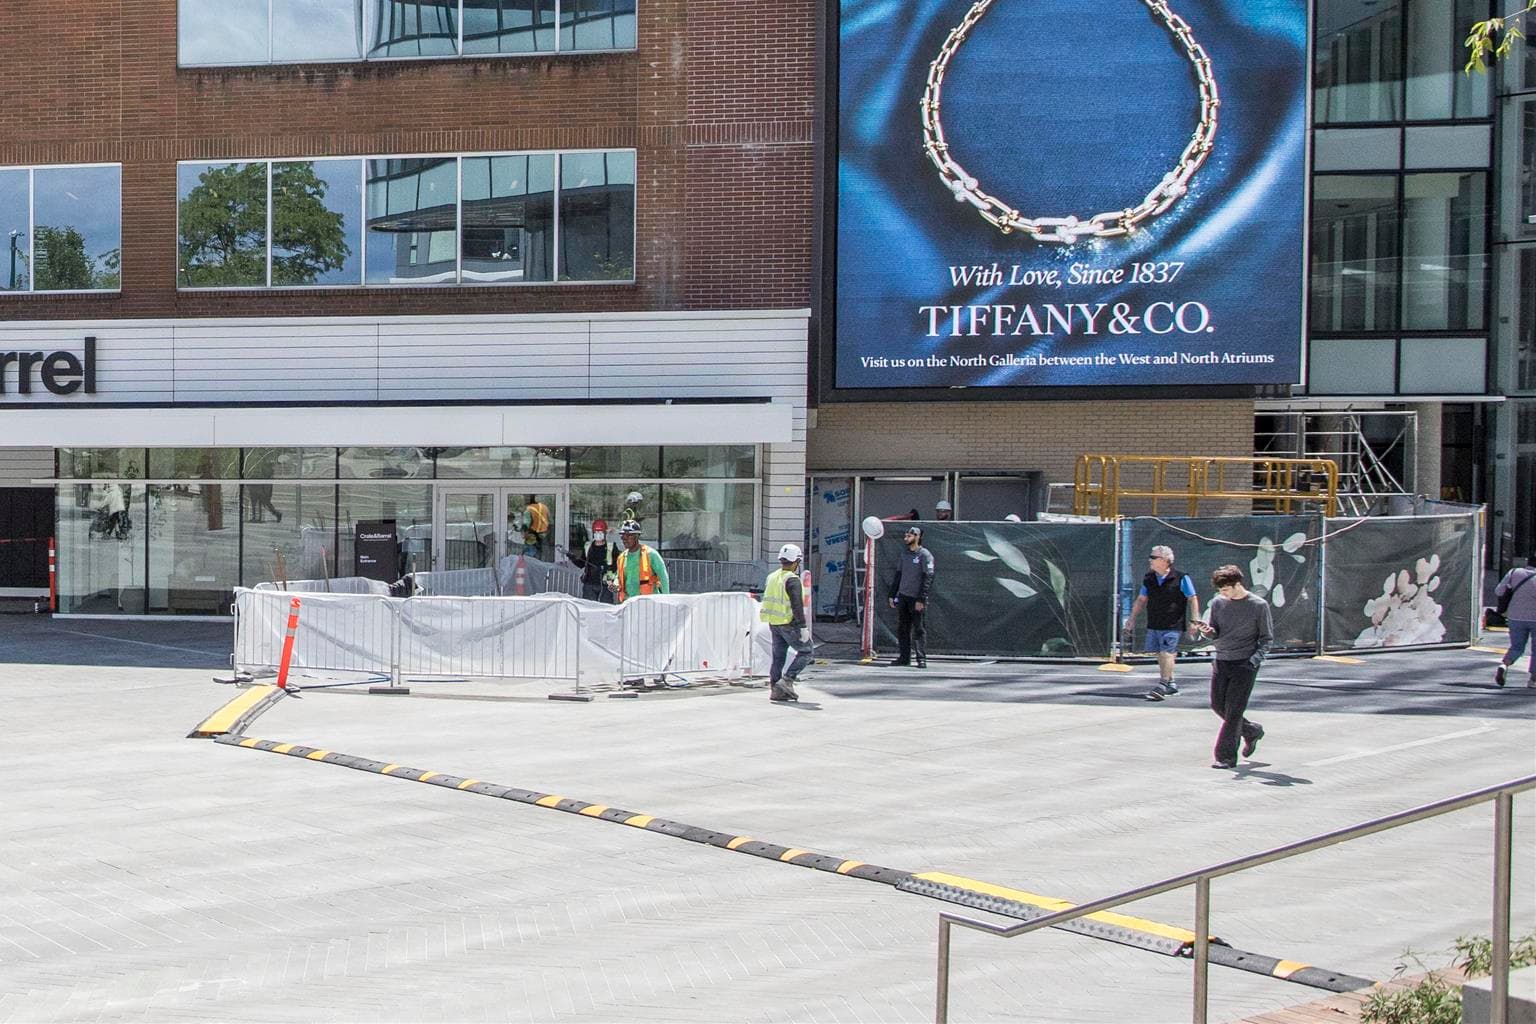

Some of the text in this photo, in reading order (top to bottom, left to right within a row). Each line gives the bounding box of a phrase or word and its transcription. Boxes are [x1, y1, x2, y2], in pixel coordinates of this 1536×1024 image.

[949, 261, 1185, 288] With Love, Since 1837
[861, 352, 1275, 368] Visit us on the North Galleria between the West and North Atriums
